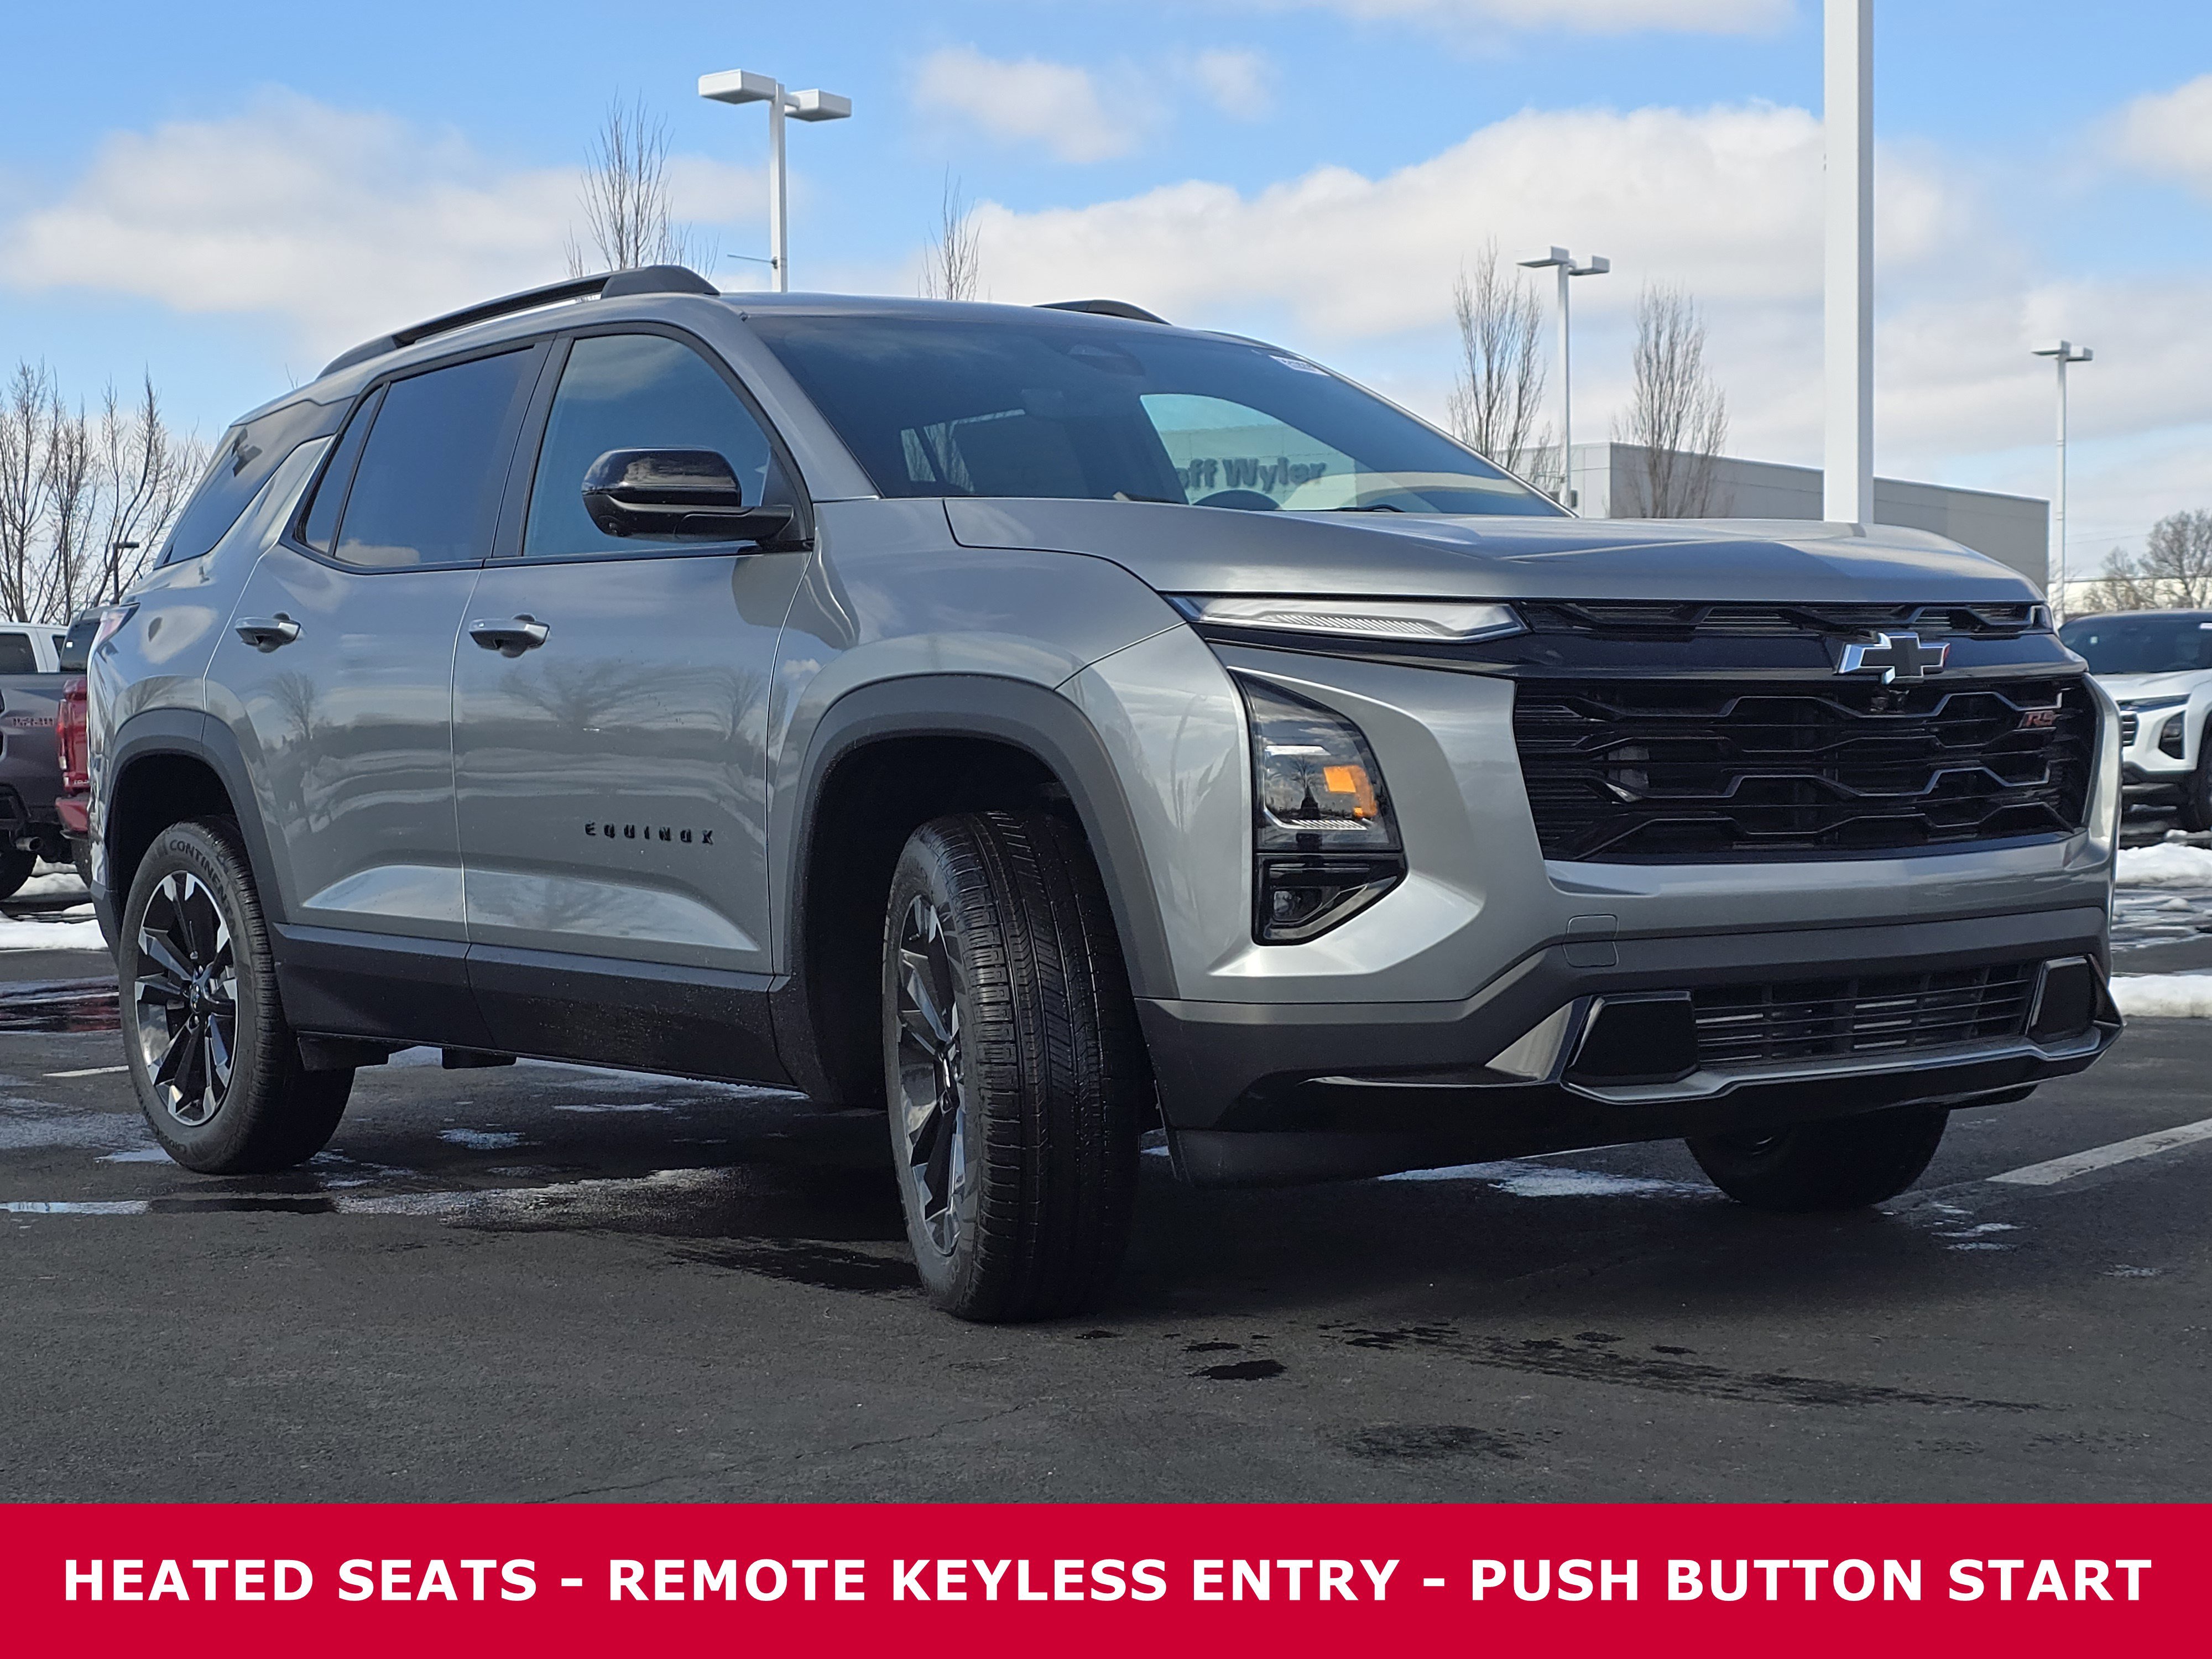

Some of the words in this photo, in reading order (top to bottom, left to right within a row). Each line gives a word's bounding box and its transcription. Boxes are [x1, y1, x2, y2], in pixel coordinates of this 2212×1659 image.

[1223, 456, 1327, 494] Wyler
[2025, 711, 2055, 727] RS
[585, 822, 713, 845] EQUINOX
